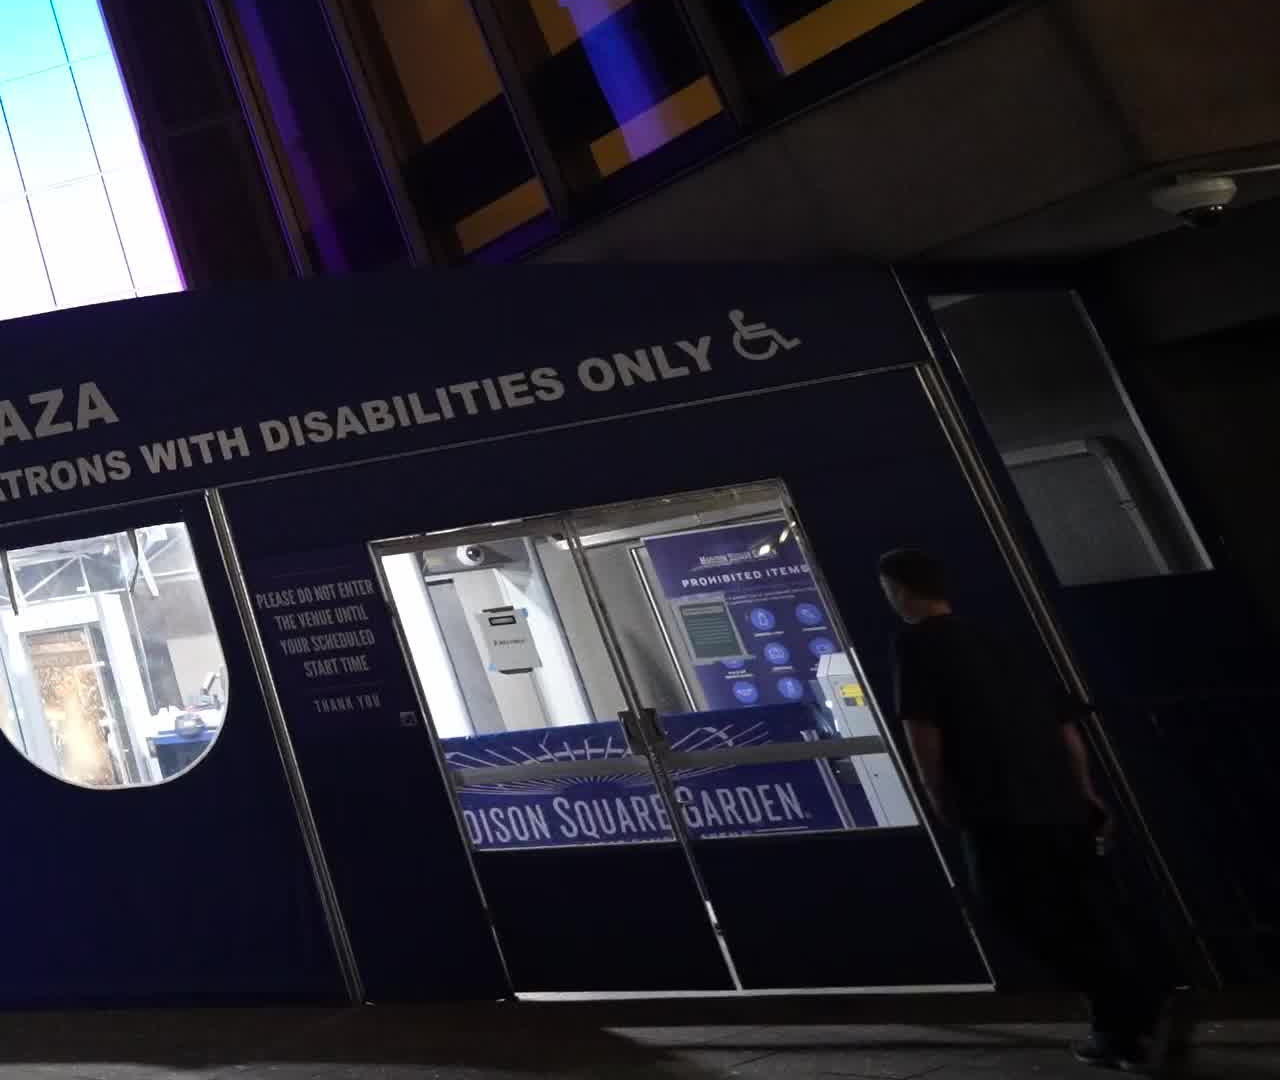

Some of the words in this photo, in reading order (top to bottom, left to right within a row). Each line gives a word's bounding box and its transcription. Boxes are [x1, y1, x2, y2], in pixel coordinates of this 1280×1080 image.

[140, 426, 251, 475] WITH
[260, 366, 565, 453] DISABILITIES
[576, 334, 713, 394] ONLY
[681, 569, 762, 589] PROHIBITED
[766, 564, 810, 577] ITEMS
[255, 589, 297, 609] PLEASE
[297, 587, 313, 604] DO
[314, 583, 337, 602] NOT
[337, 579, 375, 598] ENTER
[274, 614, 297, 632] THE
[298, 609, 333, 629] VENUE
[335, 604, 369, 624] UNTIL
[280, 637, 312, 656] YOUR
[313, 629, 376, 652] SCHEDULED
[304, 658, 339, 679] START
[341, 654, 370, 673] TIME
[313, 695, 353, 713] THANK
[357, 692, 382, 709] YOU
[552, 793, 673, 840] SQUARE
